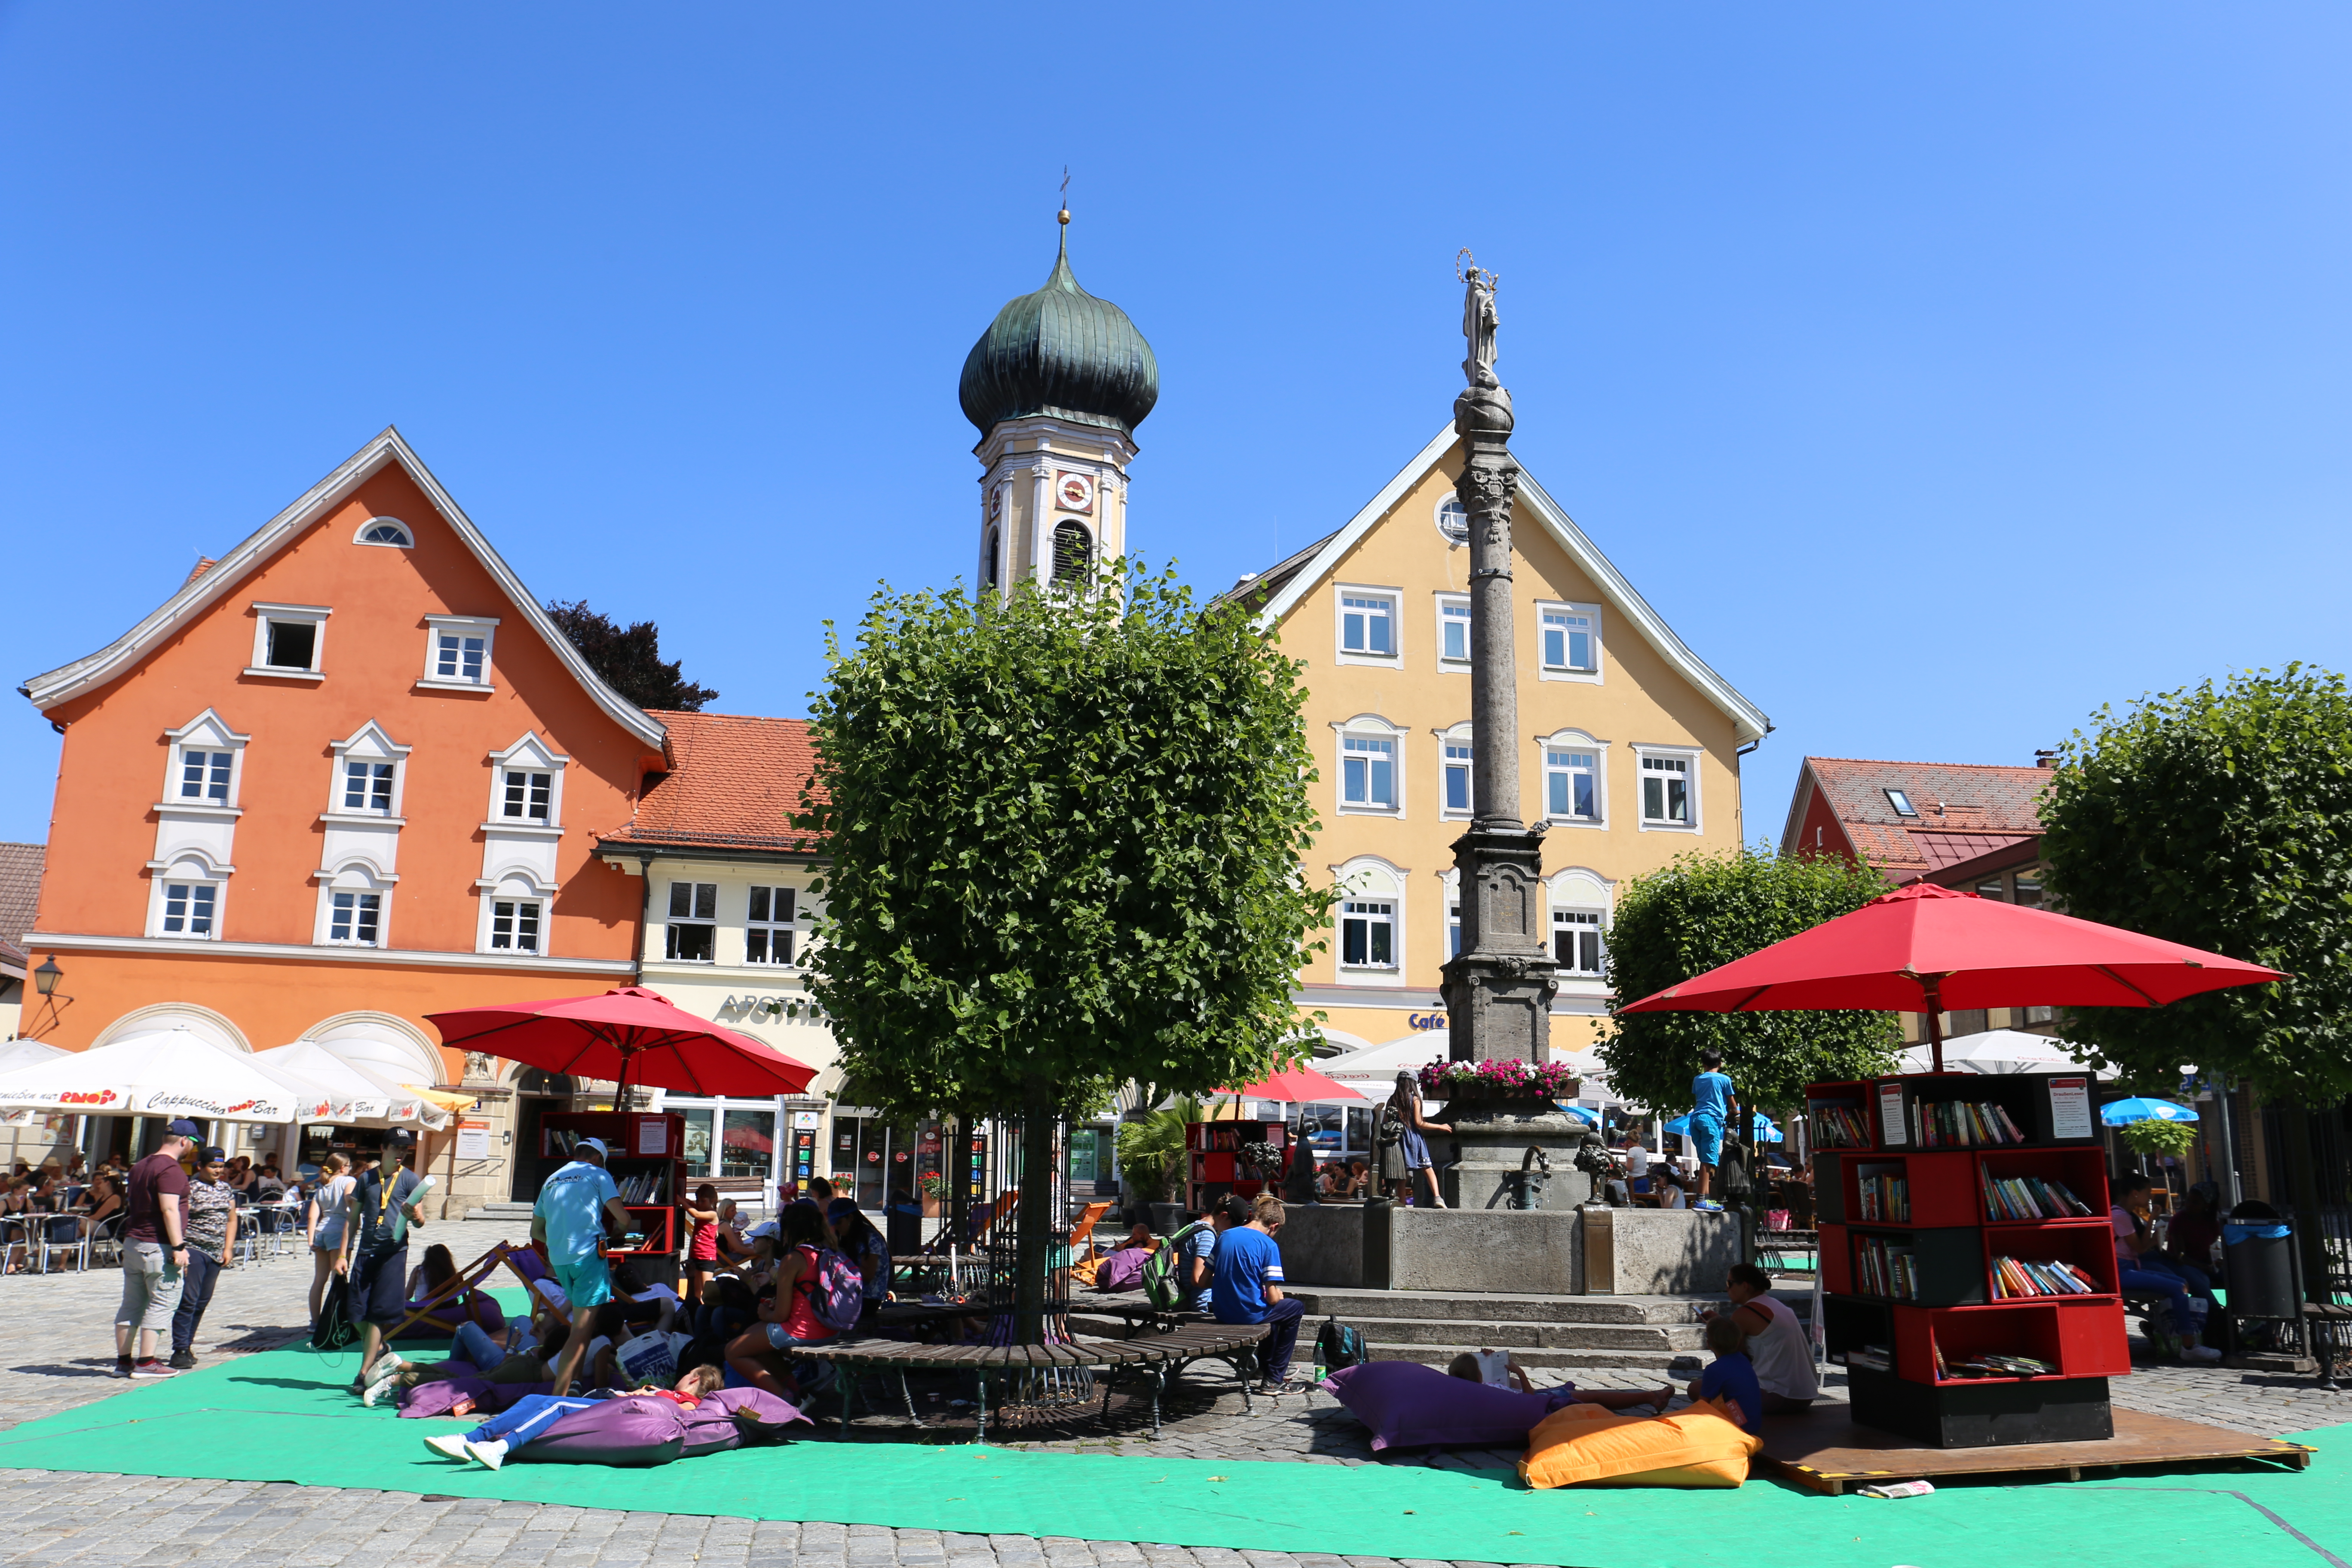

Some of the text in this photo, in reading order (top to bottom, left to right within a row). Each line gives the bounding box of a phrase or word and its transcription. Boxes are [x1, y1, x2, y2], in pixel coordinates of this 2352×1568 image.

[1409, 1014, 1445, 1028] Café
[147, 1091, 225, 1115] Cappuccino
[253, 1100, 279, 1115] Bar
[356, 1102, 374, 1112] Bar
